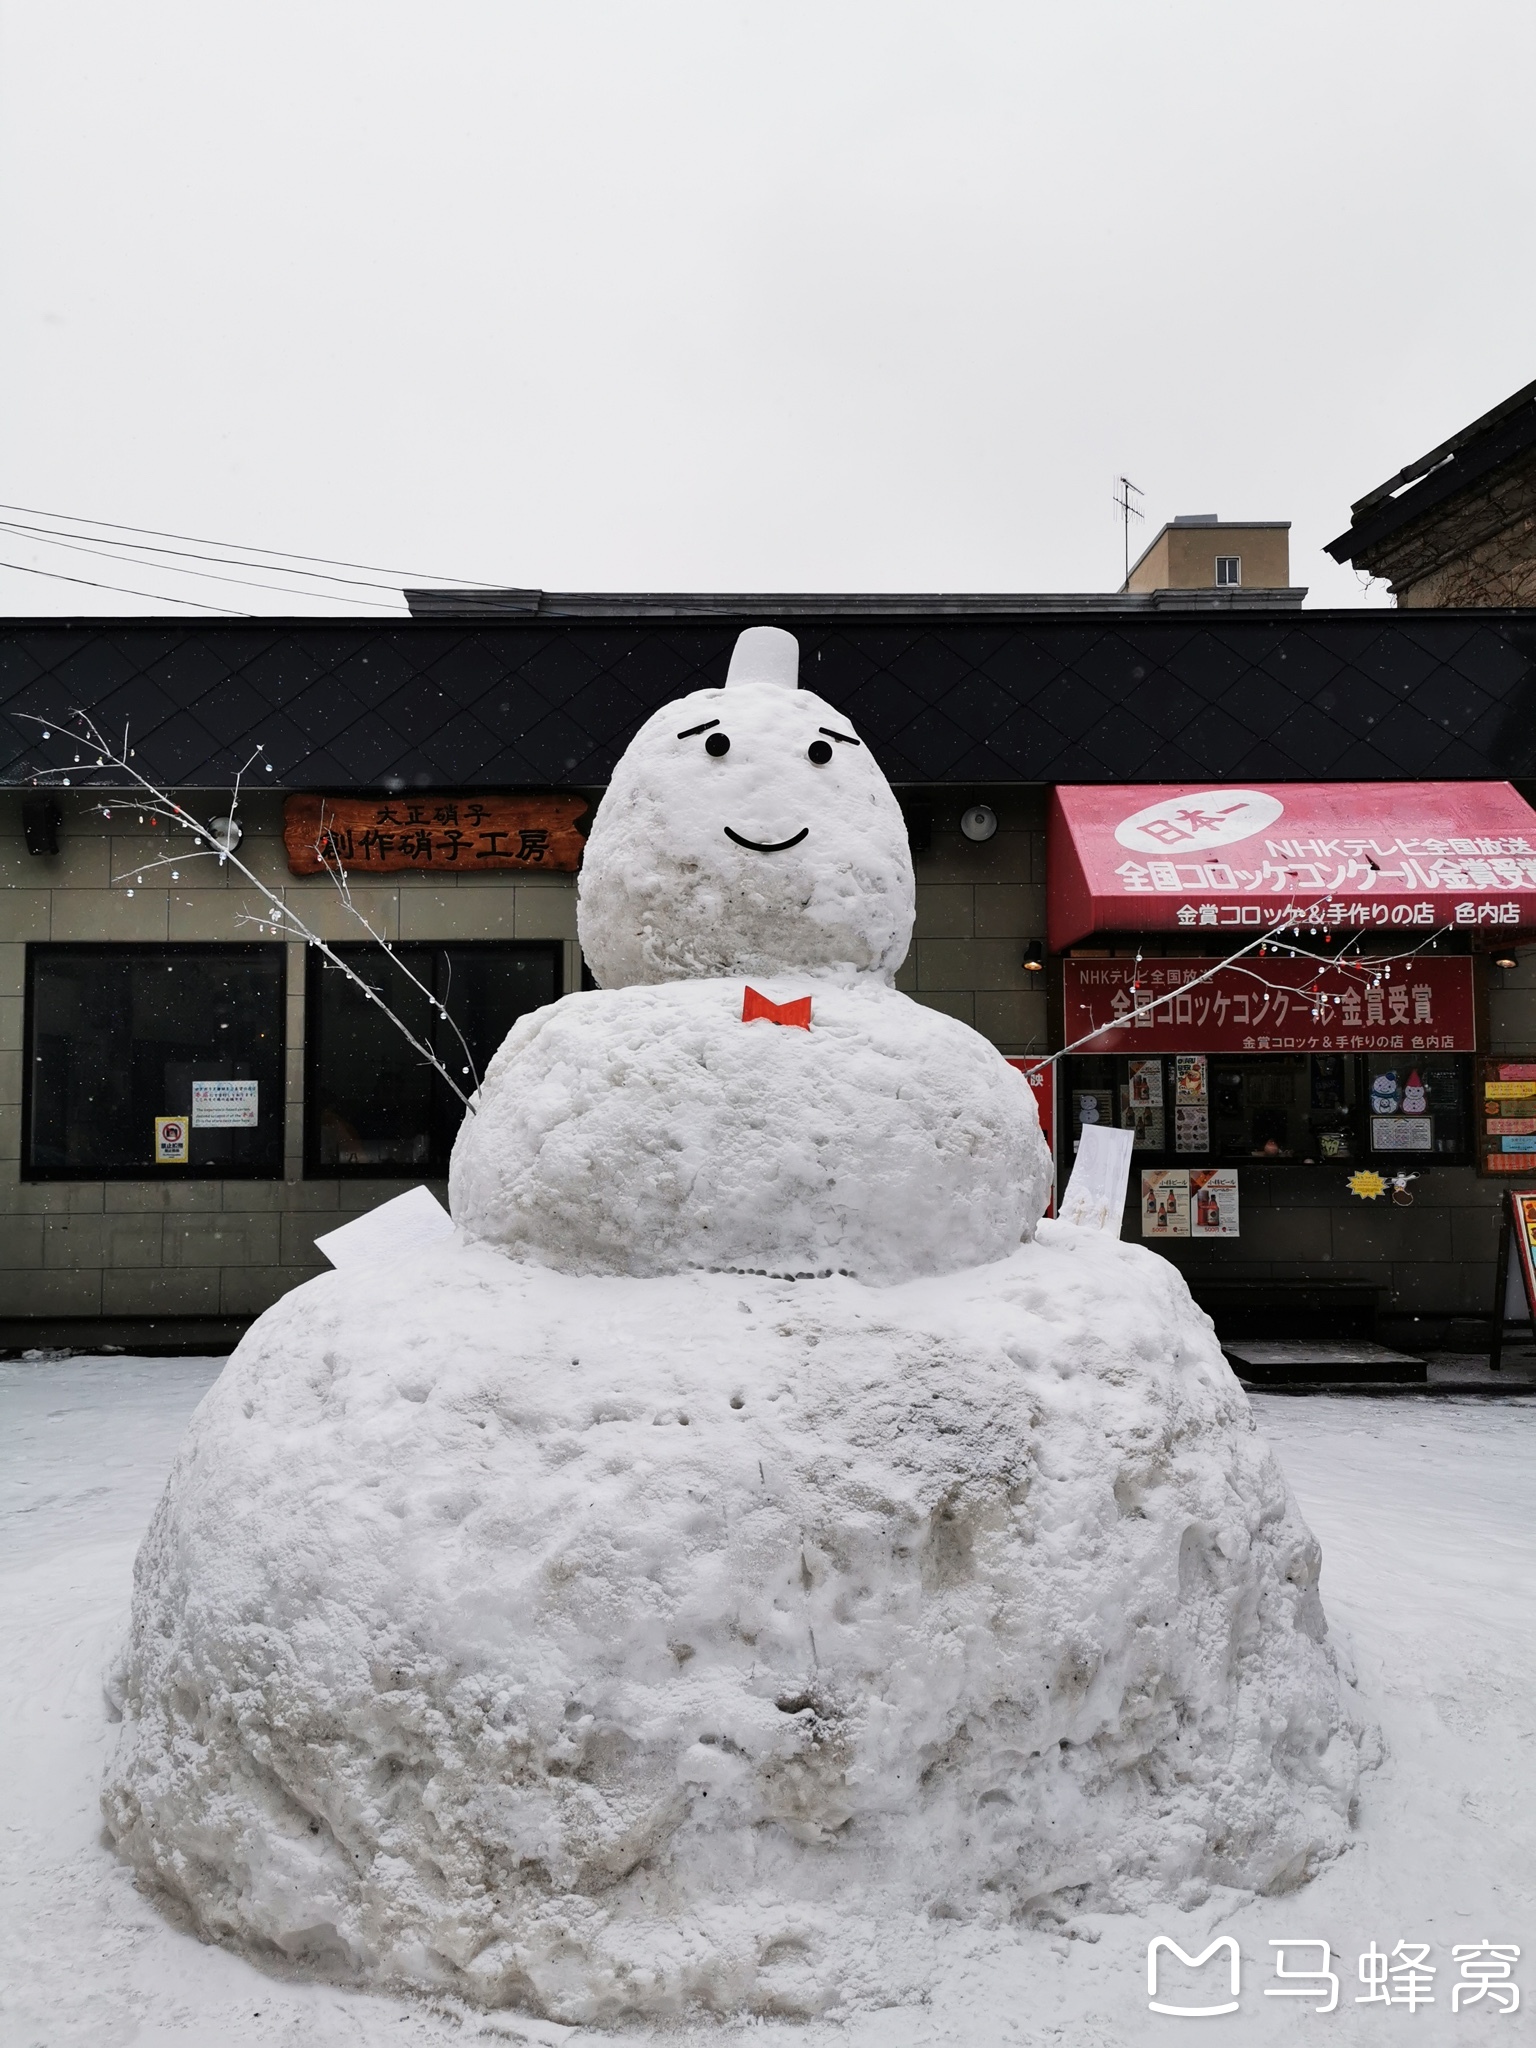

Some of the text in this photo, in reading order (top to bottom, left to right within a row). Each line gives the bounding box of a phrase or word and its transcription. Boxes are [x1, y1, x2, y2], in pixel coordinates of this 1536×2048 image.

[377, 805, 492, 826] 大正硝子
[1137, 803, 1250, 845] 日本一
[321, 829, 550, 862] 創作硝子工房
[1265, 837, 1536, 858] NHKテレビ全国放送
[1455, 902, 1521, 924] 色内店
[1080, 968, 1214, 985] NHKテレビ全国放送
[1411, 1035, 1455, 1049] 色内店
